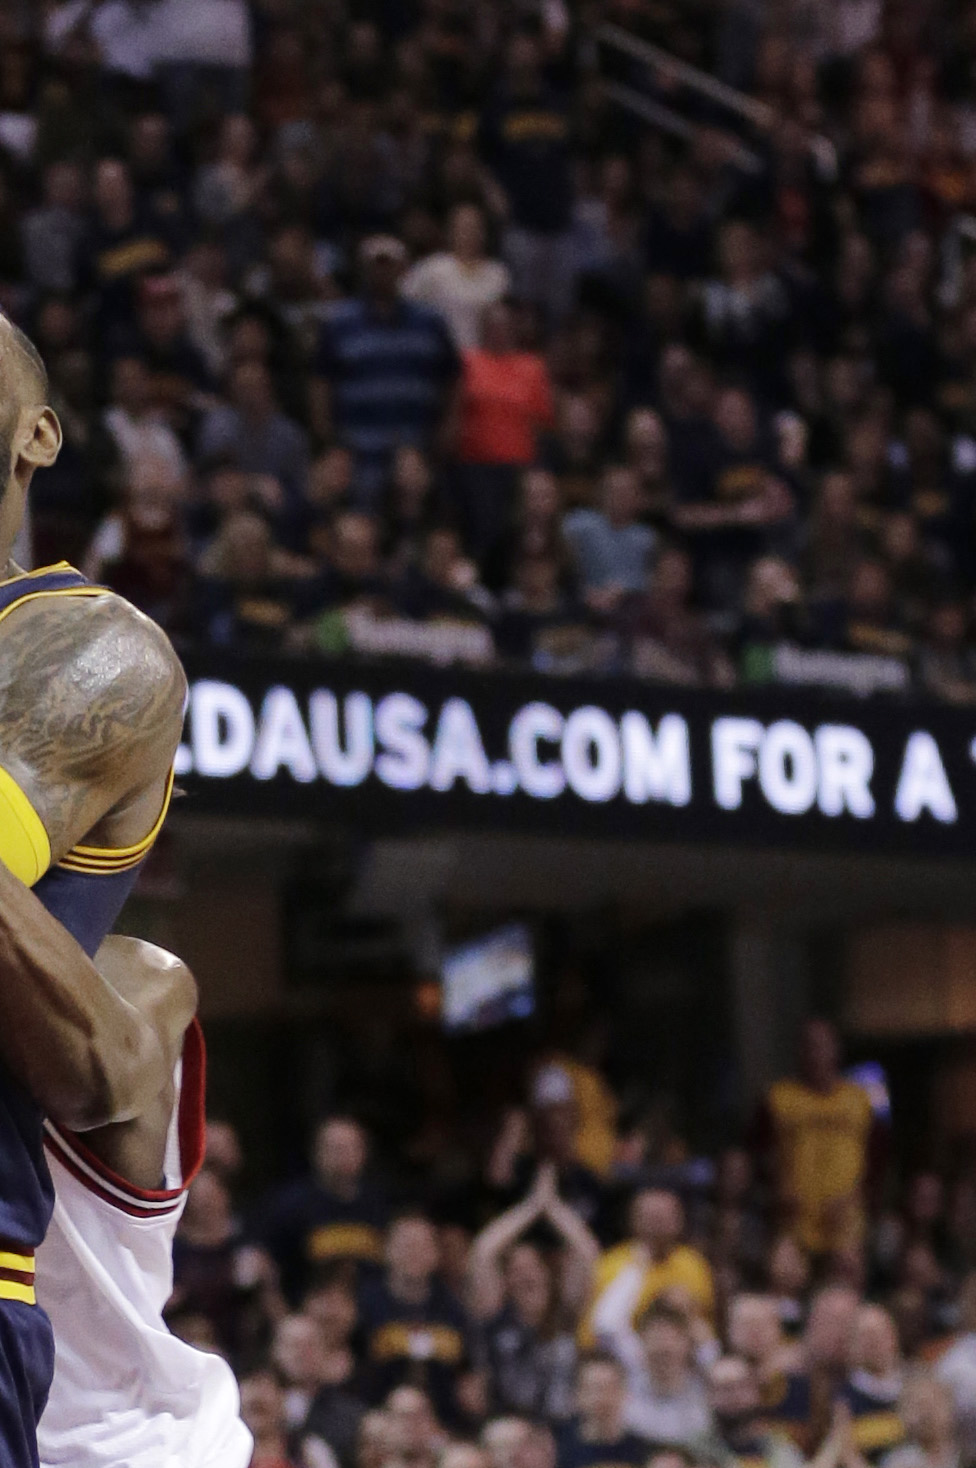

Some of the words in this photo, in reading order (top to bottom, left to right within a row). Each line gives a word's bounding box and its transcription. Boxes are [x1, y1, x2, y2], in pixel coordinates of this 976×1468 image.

[173, 678, 691, 806] DAUSA.COM
[711, 716, 876, 820] FOR
[893, 730, 958, 824] A
